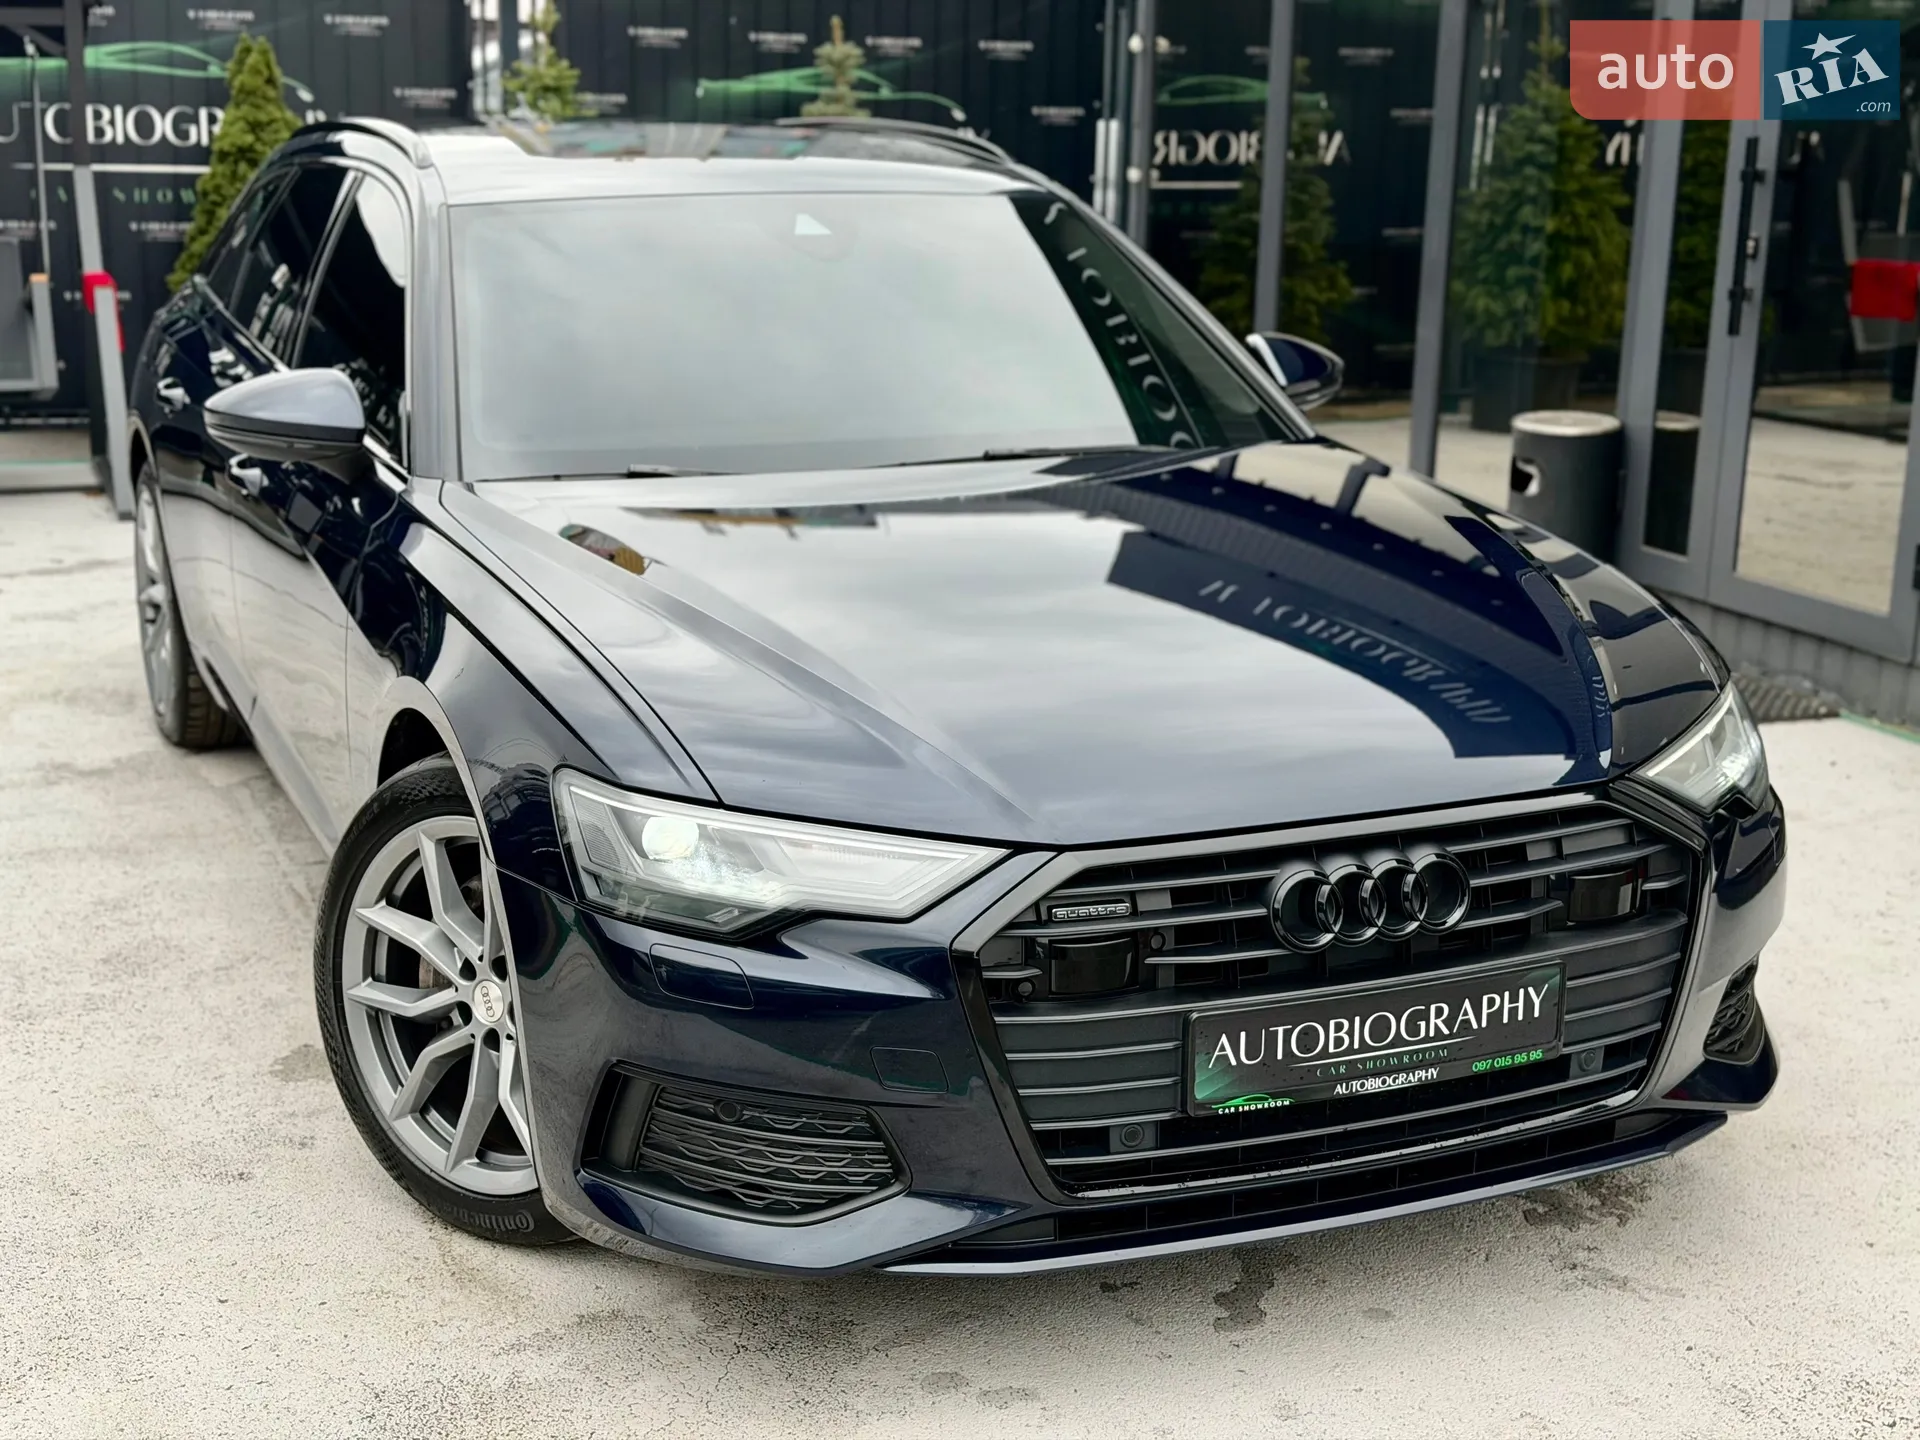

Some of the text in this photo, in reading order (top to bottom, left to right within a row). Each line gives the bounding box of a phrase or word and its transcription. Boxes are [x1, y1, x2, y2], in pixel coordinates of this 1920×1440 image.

[1056, 906, 1126, 918] quattro
[1208, 985, 1549, 1069] AUTOBIOGRAPHY
[1316, 1048, 1448, 1078] CAR SHOWROOM
[1471, 1049, 1544, 1073] 097 015 95 95
[1333, 1066, 1440, 1095] AUTOBIOGRAPHY
[1218, 1100, 1290, 1115] CAR SHOWROOM
